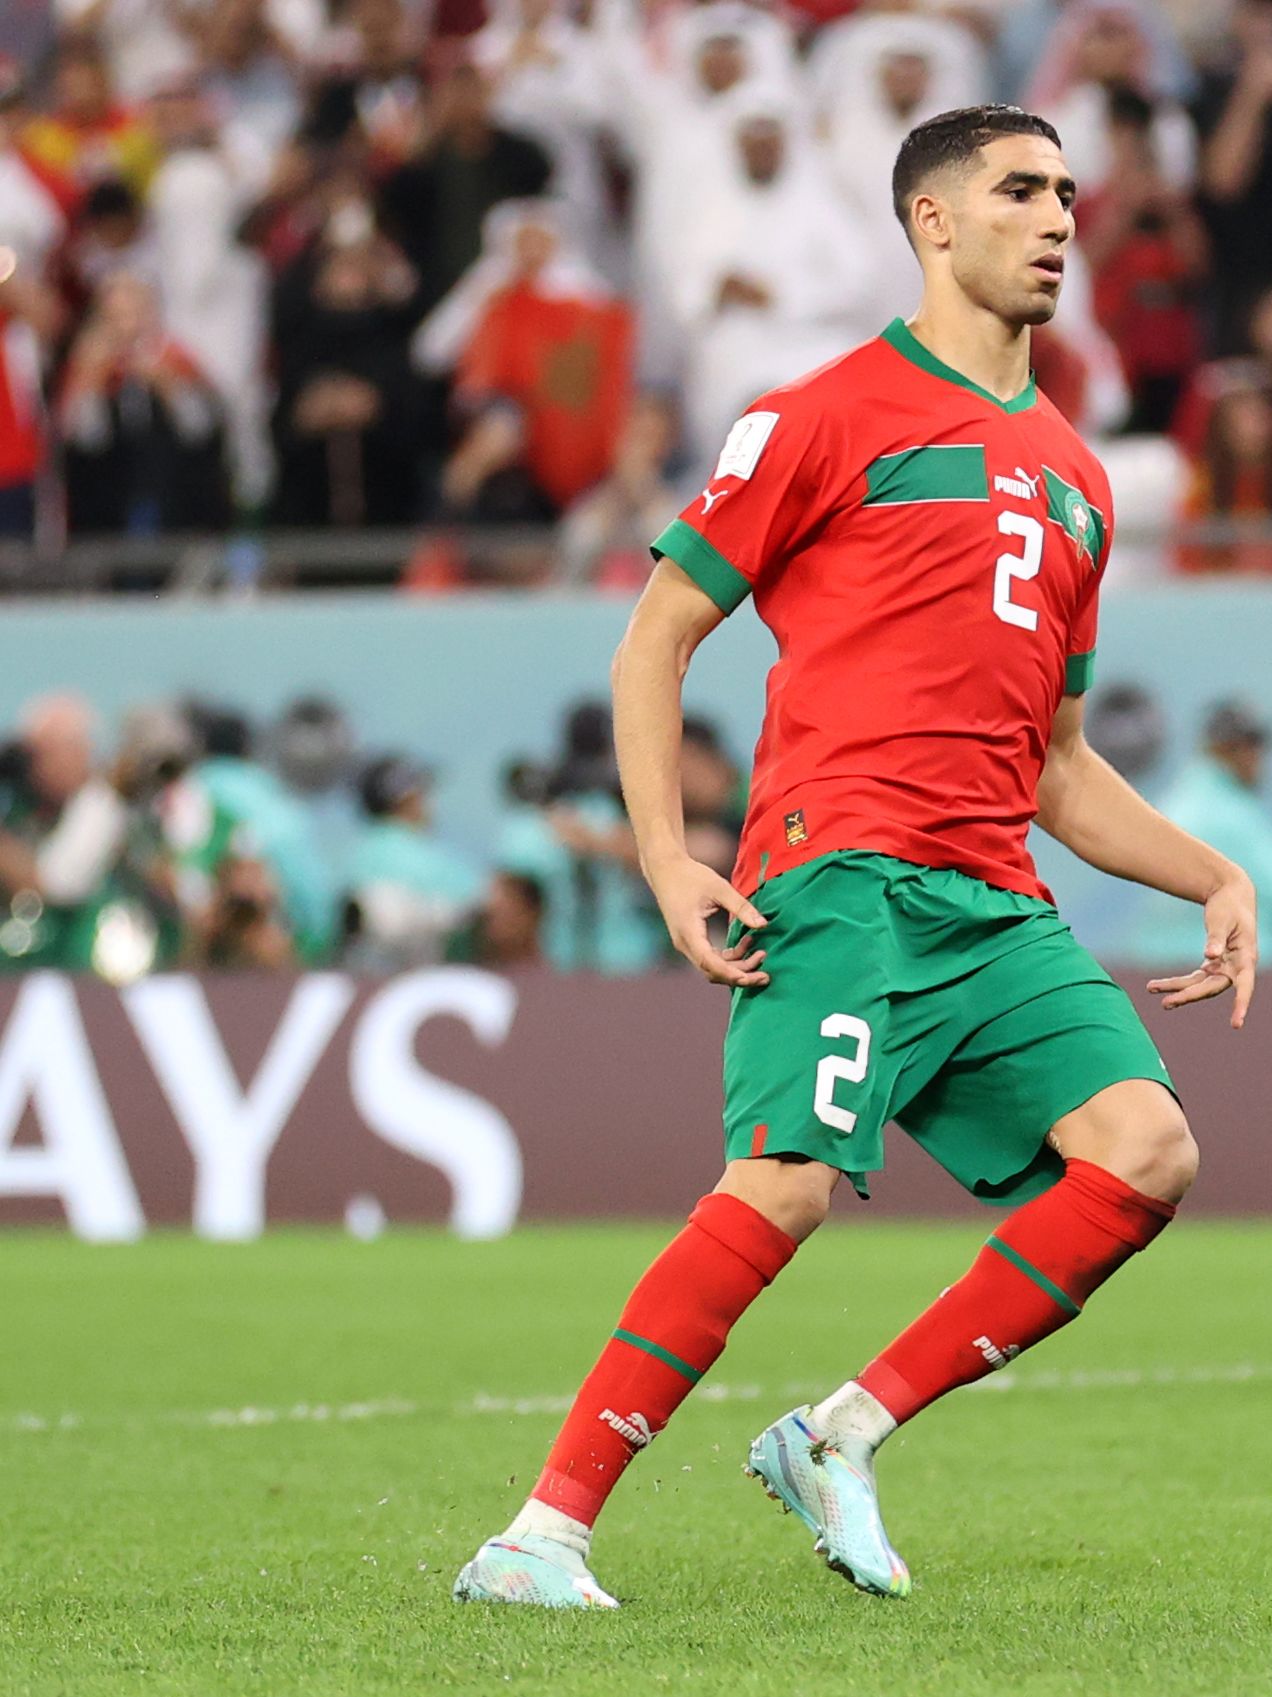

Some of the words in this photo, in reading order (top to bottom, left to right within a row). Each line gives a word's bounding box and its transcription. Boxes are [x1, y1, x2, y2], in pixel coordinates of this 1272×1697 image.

[994, 475, 1031, 500] PUMA
[993, 510, 1044, 631] 2
[814, 1013, 871, 1134] 2
